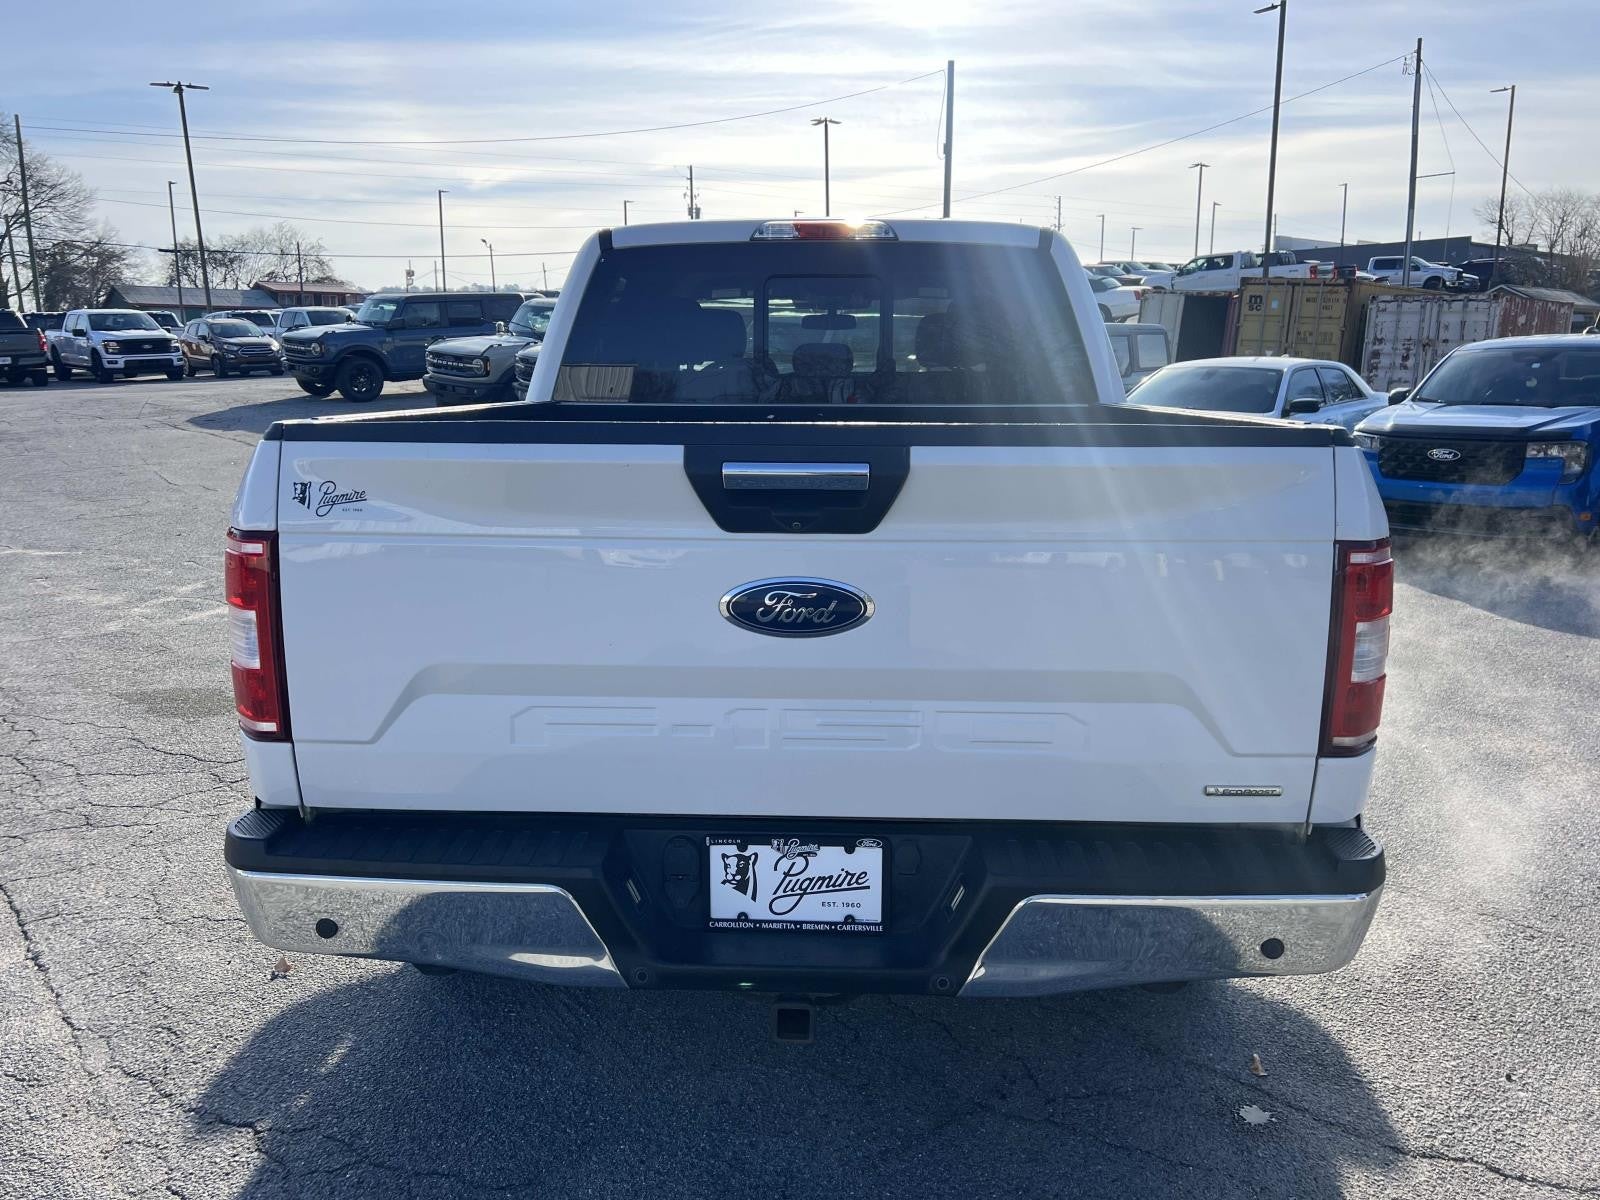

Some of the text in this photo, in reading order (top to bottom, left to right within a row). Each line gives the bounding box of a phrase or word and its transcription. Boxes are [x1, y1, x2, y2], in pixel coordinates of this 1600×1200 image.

[315, 480, 368, 517] Pugmire
[755, 590, 838, 624] Ford
[510, 705, 1091, 755] F-150
[786, 838, 820, 860] Pugmire
[768, 854, 870, 916] Pugmire
[709, 921, 754, 929] CARROLLTON
[802, 923, 830, 931] BREMEN
[837, 924, 884, 932] CARTERSVILLE
